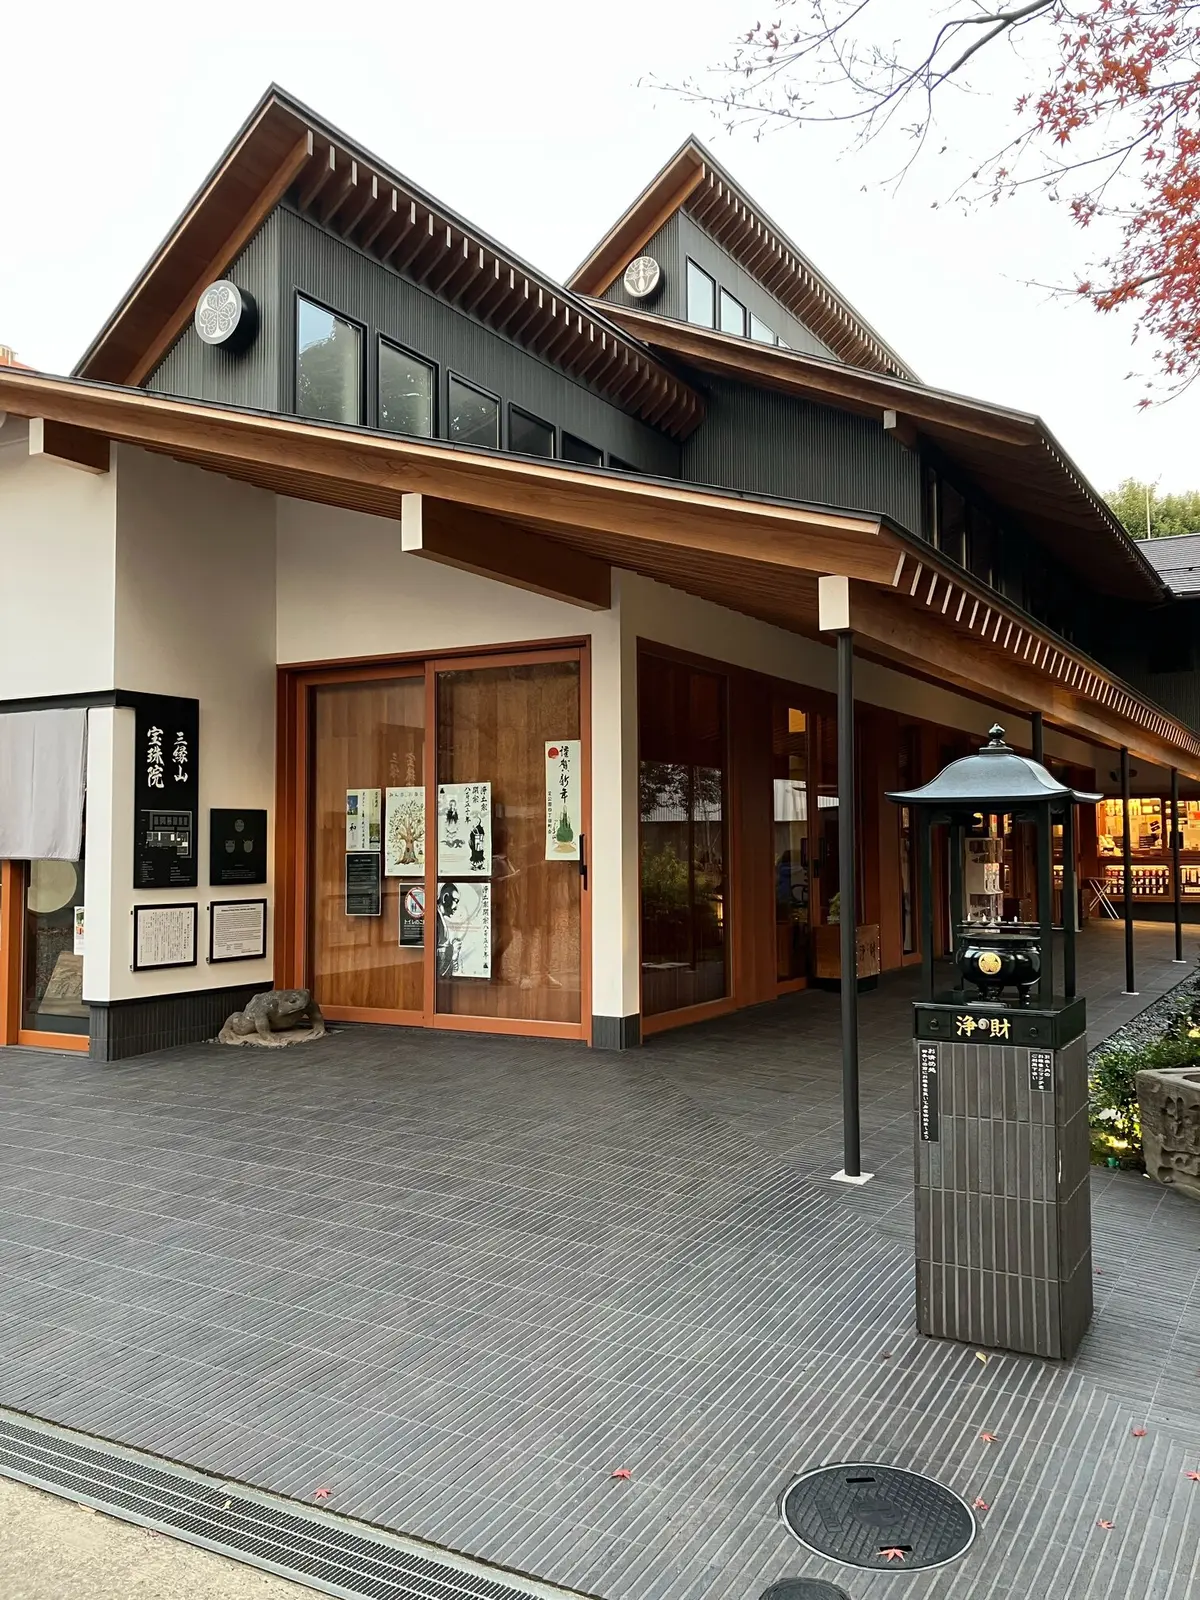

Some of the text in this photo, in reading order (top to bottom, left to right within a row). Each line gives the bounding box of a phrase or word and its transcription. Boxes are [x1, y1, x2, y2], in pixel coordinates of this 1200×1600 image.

[146, 725, 165, 789] 宝珠院
[172, 731, 188, 783] 三縁山
[559, 745, 570, 803] 謹賀新年
[955, 1015, 1012, 1040] 浄財
